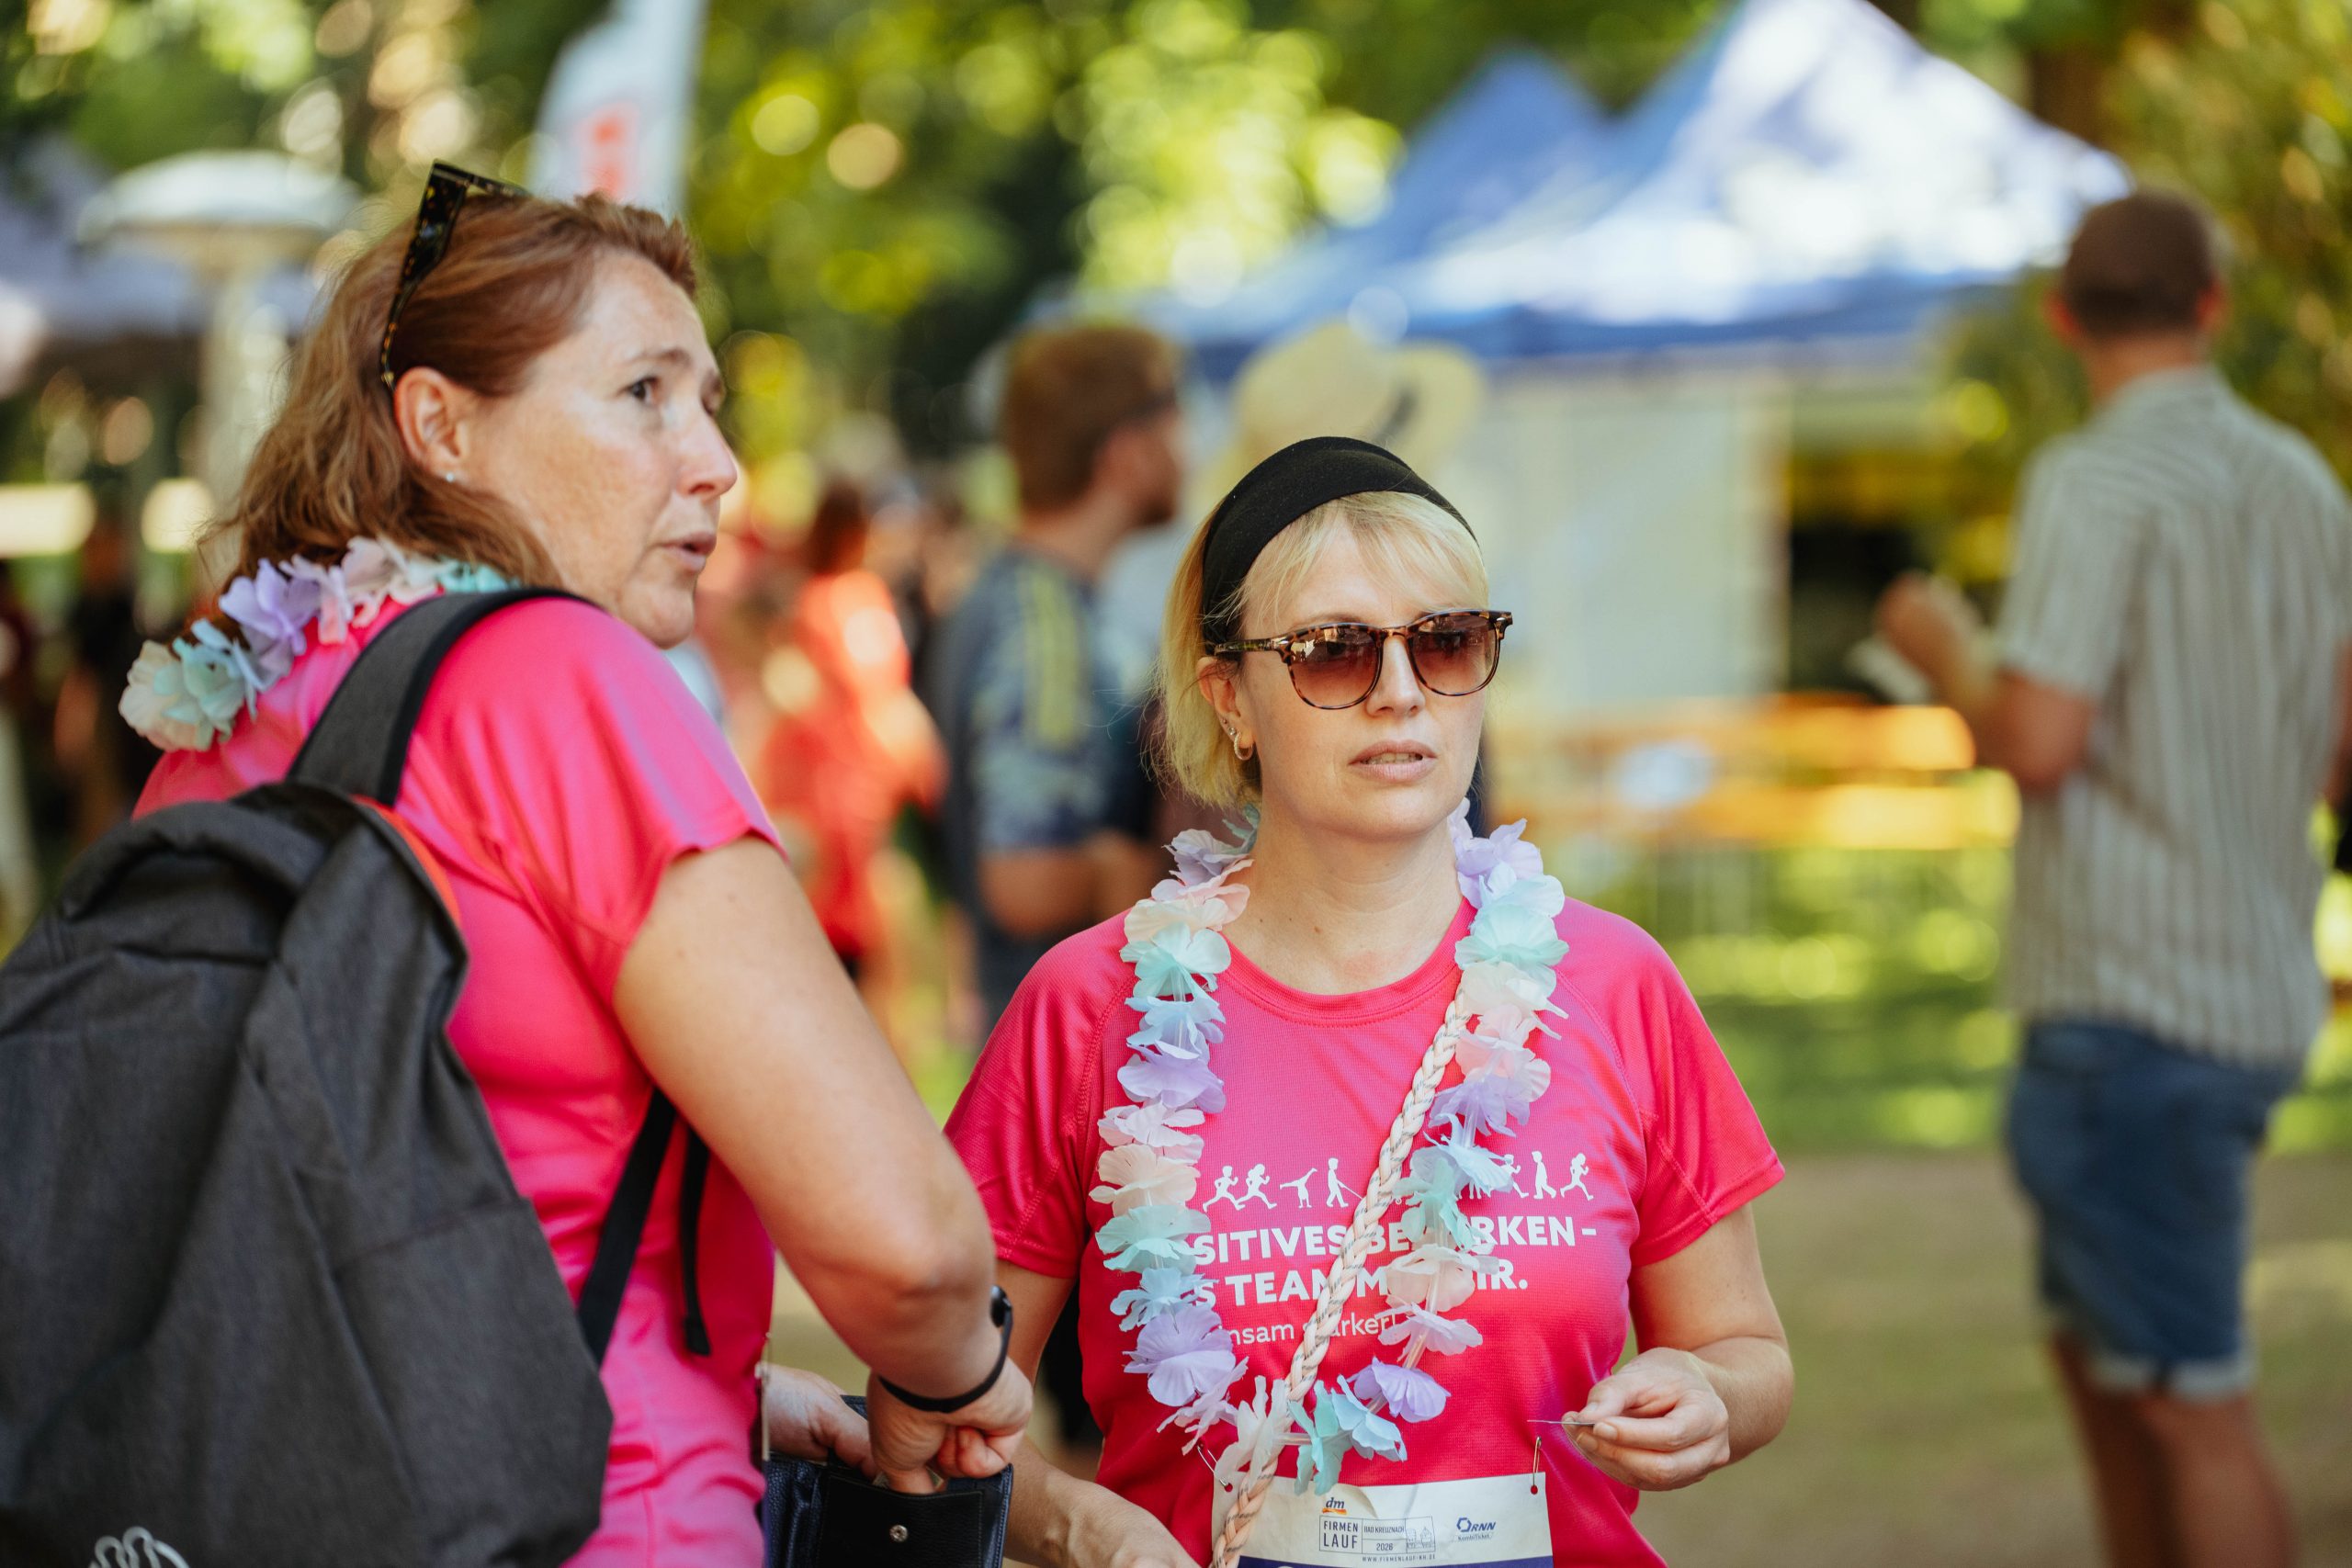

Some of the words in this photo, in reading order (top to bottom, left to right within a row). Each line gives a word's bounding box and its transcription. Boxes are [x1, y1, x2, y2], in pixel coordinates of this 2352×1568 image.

[1193, 1224, 1348, 1266] SITIVES
[1367, 1215, 1577, 1255] BERKEN
[1476, 1258, 1529, 1291] IR.
[1325, 1496, 1345, 1509] dm
[1323, 1520, 1359, 1532] FIRMEN
[1374, 1526, 1405, 1534] KREUZNACH
[1470, 1522, 1497, 1532] RNN
[1323, 1532, 1358, 1549] LAUF
